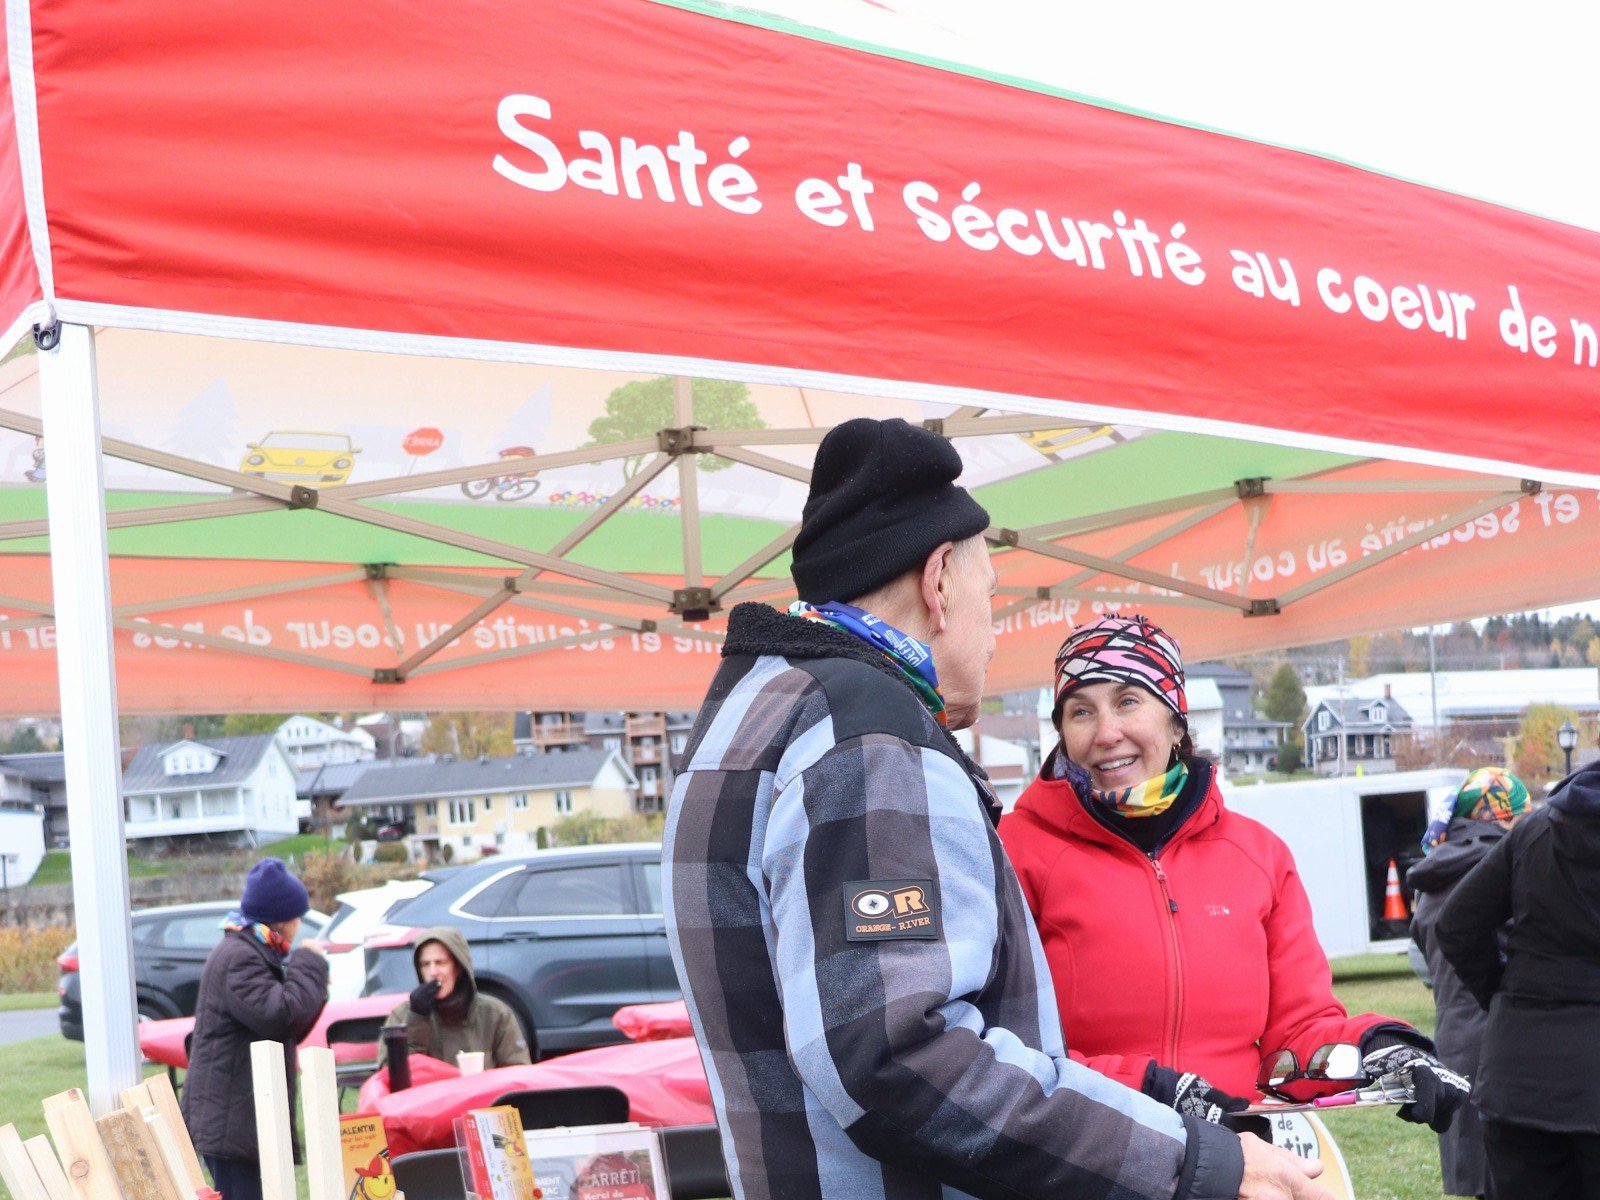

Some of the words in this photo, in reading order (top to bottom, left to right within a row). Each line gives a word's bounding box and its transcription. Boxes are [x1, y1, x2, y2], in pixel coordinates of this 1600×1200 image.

[492, 93, 763, 214] Santé
[795, 162, 875, 232] et
[902, 181, 1206, 286] sécurité
[1229, 248, 1301, 307] au
[1316, 266, 1476, 341] coeur
[1499, 285, 1558, 359] de
[899, 916, 931, 931] RIVER
